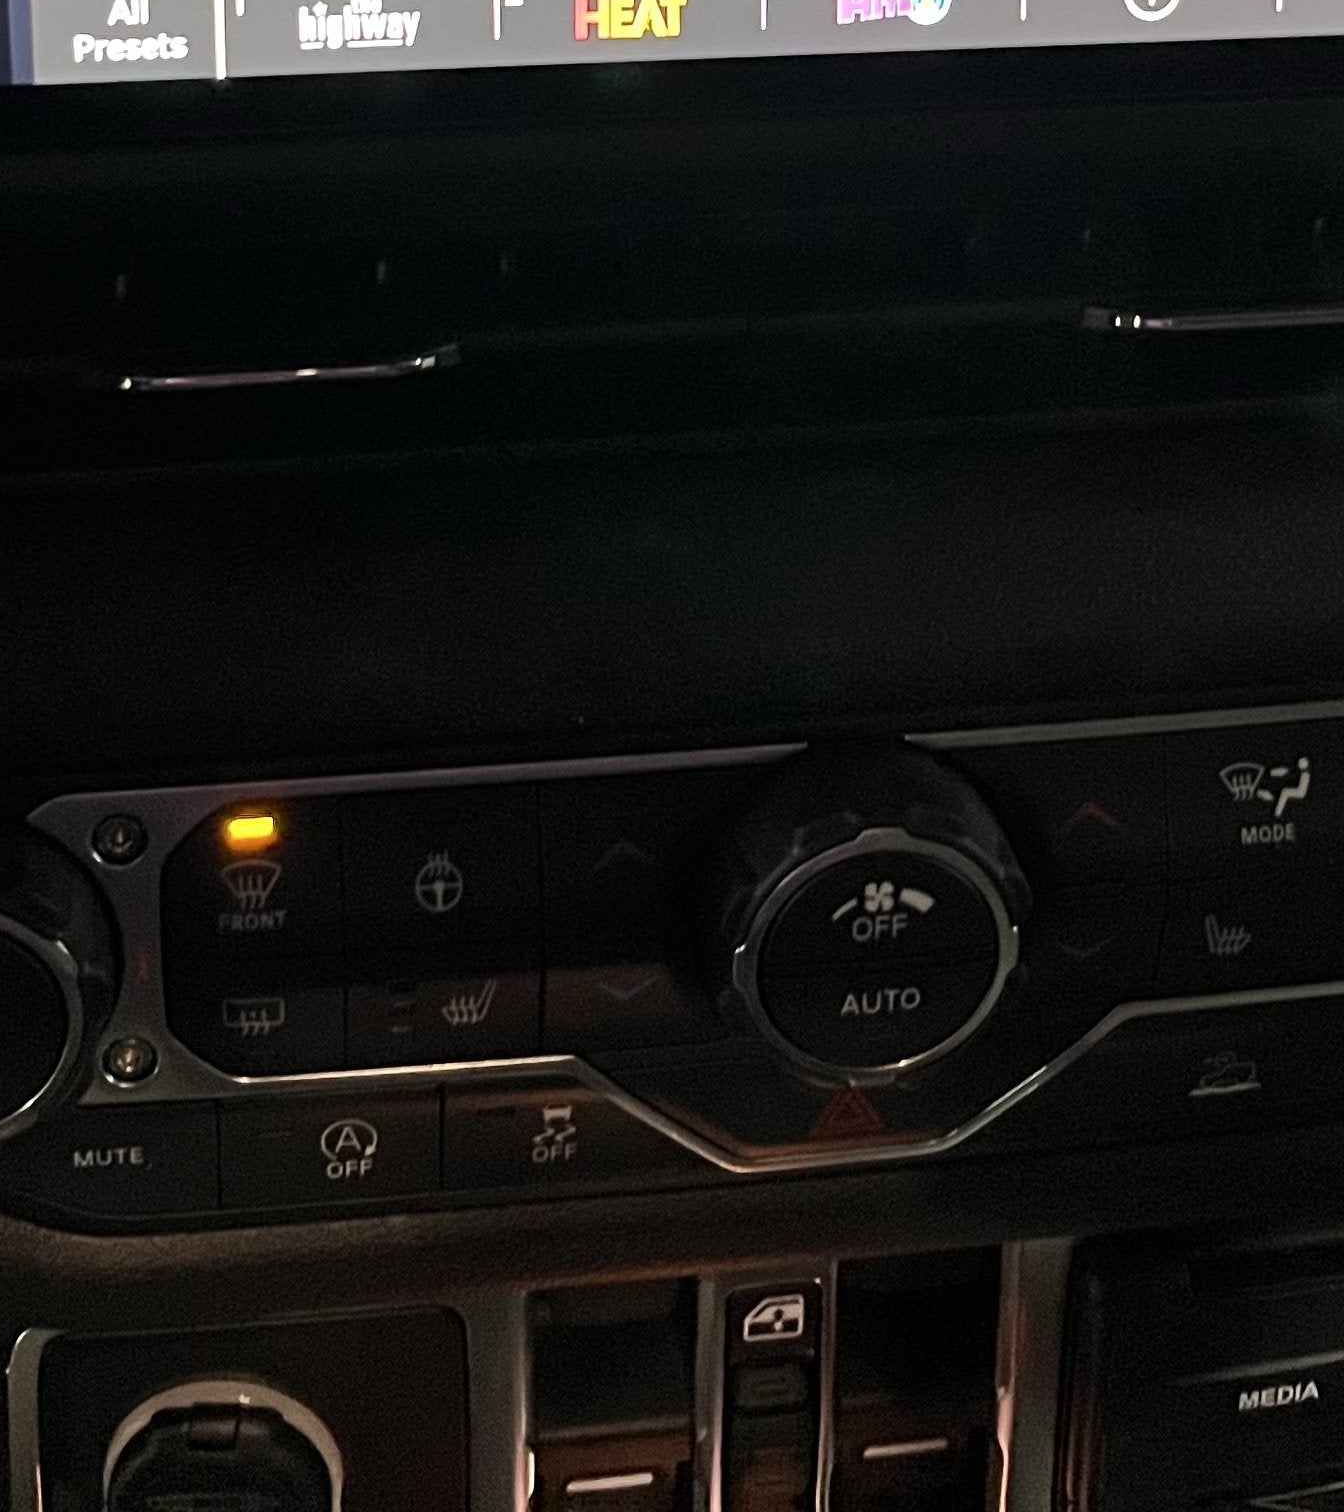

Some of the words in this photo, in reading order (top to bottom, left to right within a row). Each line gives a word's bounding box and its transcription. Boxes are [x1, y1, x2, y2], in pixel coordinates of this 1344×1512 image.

[299, 4, 421, 50] highway
[73, 32, 188, 63] Presets
[1240, 823, 1296, 846] MODE
[851, 913, 908, 942] OFF
[840, 988, 922, 1016] AUTO
[73, 1148, 145, 1169] MUTE
[531, 1143, 577, 1163] OFF
[325, 1158, 374, 1180] OFF
[1239, 1381, 1319, 1410] MEDIA
